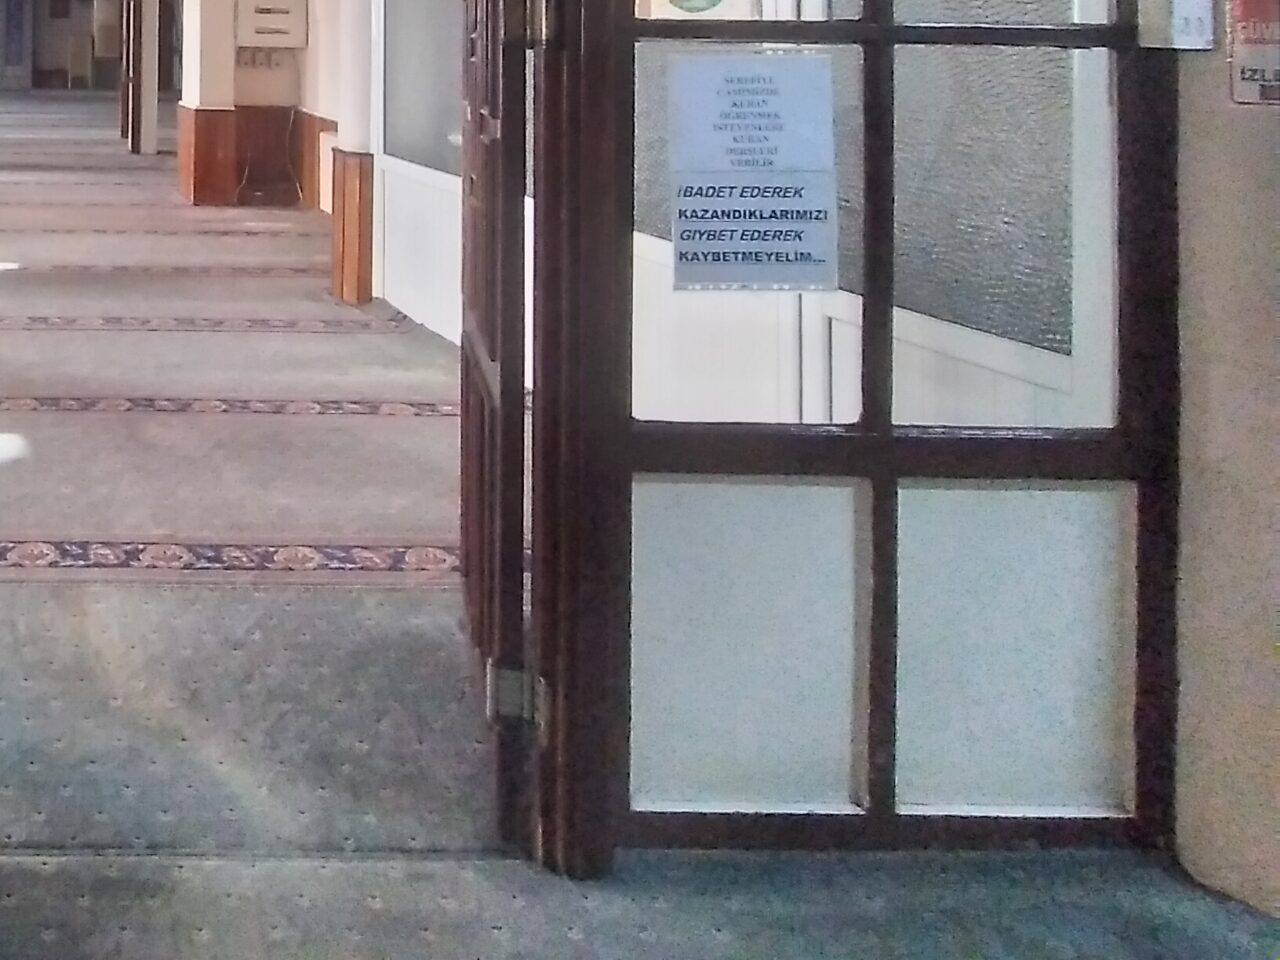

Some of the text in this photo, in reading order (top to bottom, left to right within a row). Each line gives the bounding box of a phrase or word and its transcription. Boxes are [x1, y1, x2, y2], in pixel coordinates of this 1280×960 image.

[739, 186, 805, 199] EDEREK
[678, 209, 828, 221] KAZANDIKLARIMIZI
[739, 229, 805, 242] EDEREK
[679, 250, 827, 263] KAYBETMEYELİM...
